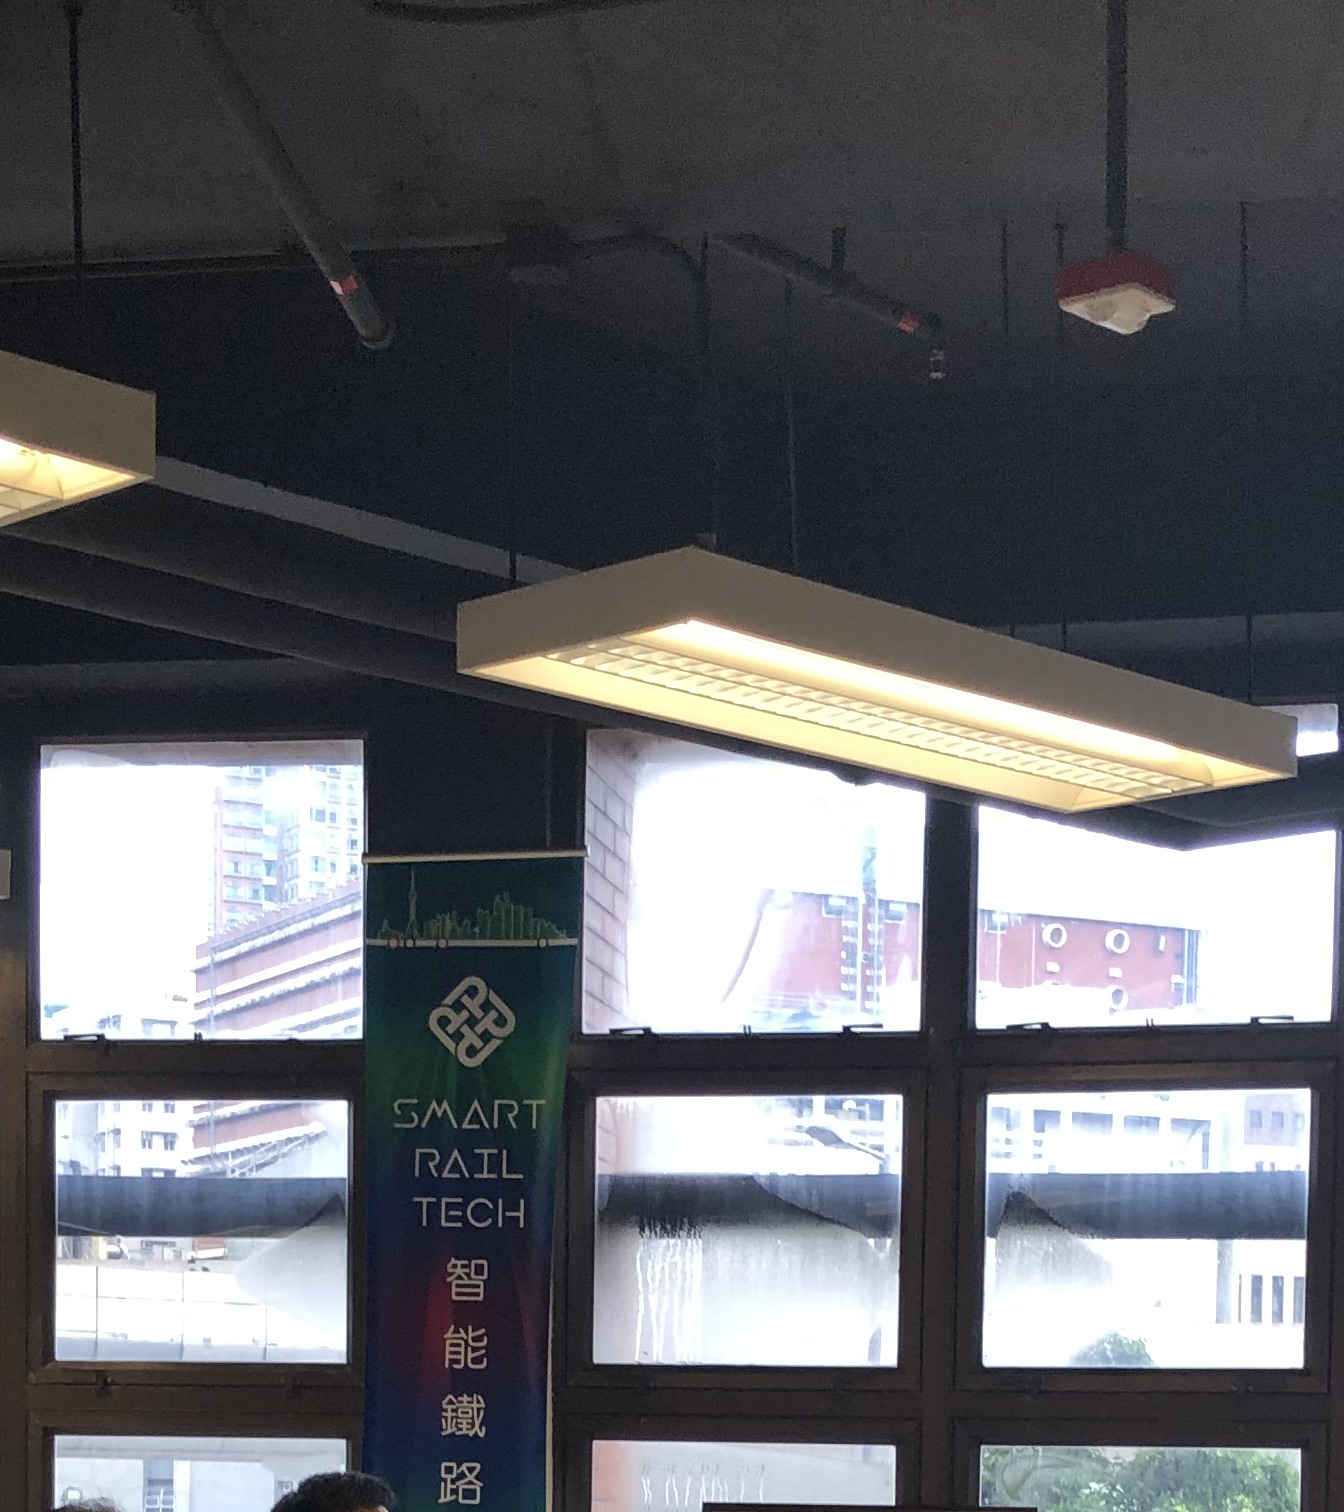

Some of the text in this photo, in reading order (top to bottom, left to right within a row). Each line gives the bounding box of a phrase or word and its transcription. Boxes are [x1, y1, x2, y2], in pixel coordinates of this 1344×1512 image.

[393, 1099, 546, 1129] SMART
[414, 1148, 524, 1180] RAIL
[413, 1197, 526, 1228] TECH
